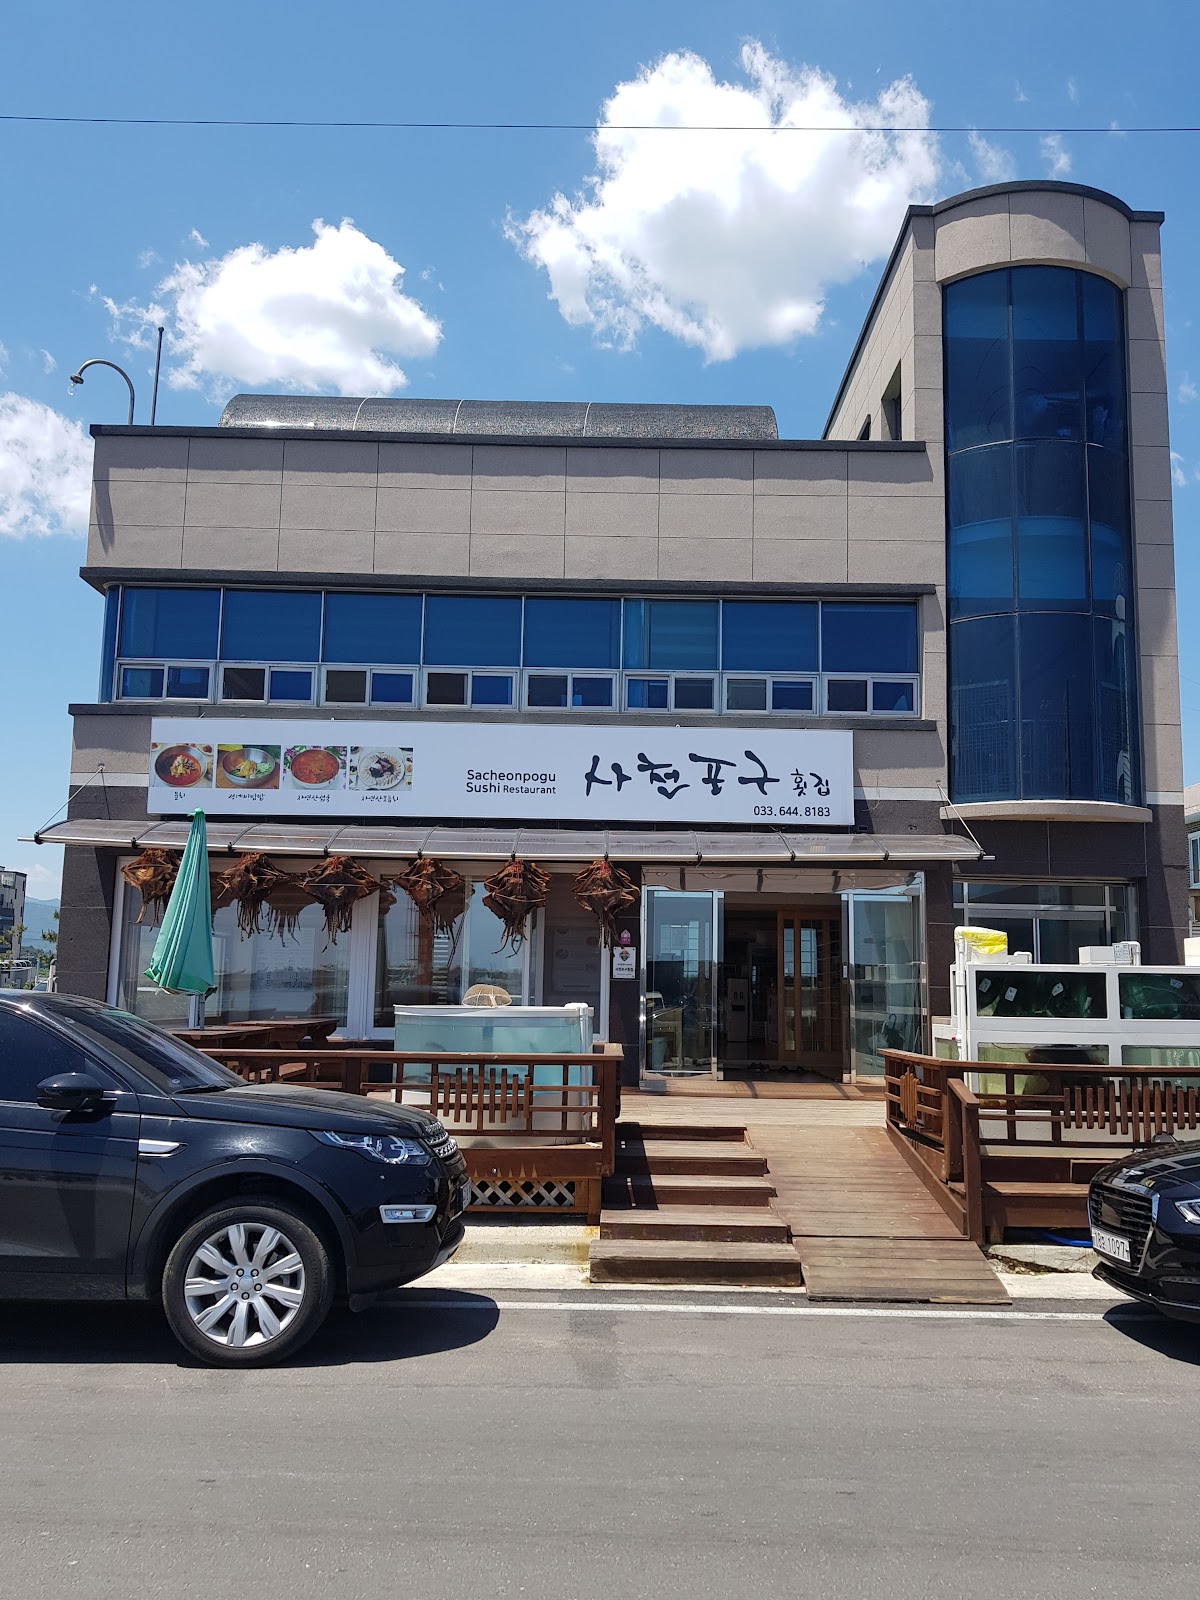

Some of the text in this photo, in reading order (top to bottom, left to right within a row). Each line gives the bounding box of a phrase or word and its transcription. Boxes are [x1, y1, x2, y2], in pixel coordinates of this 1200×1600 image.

[466, 769, 556, 784] Sacheonpogu
[584, 750, 831, 800] 사천포구 횟집
[465, 781, 556, 794] Sushi Restaurant
[174, 791, 186, 801] 물회
[753, 805, 831, 817] 033.644.8183
[1107, 1238, 1125, 1258] 1097
